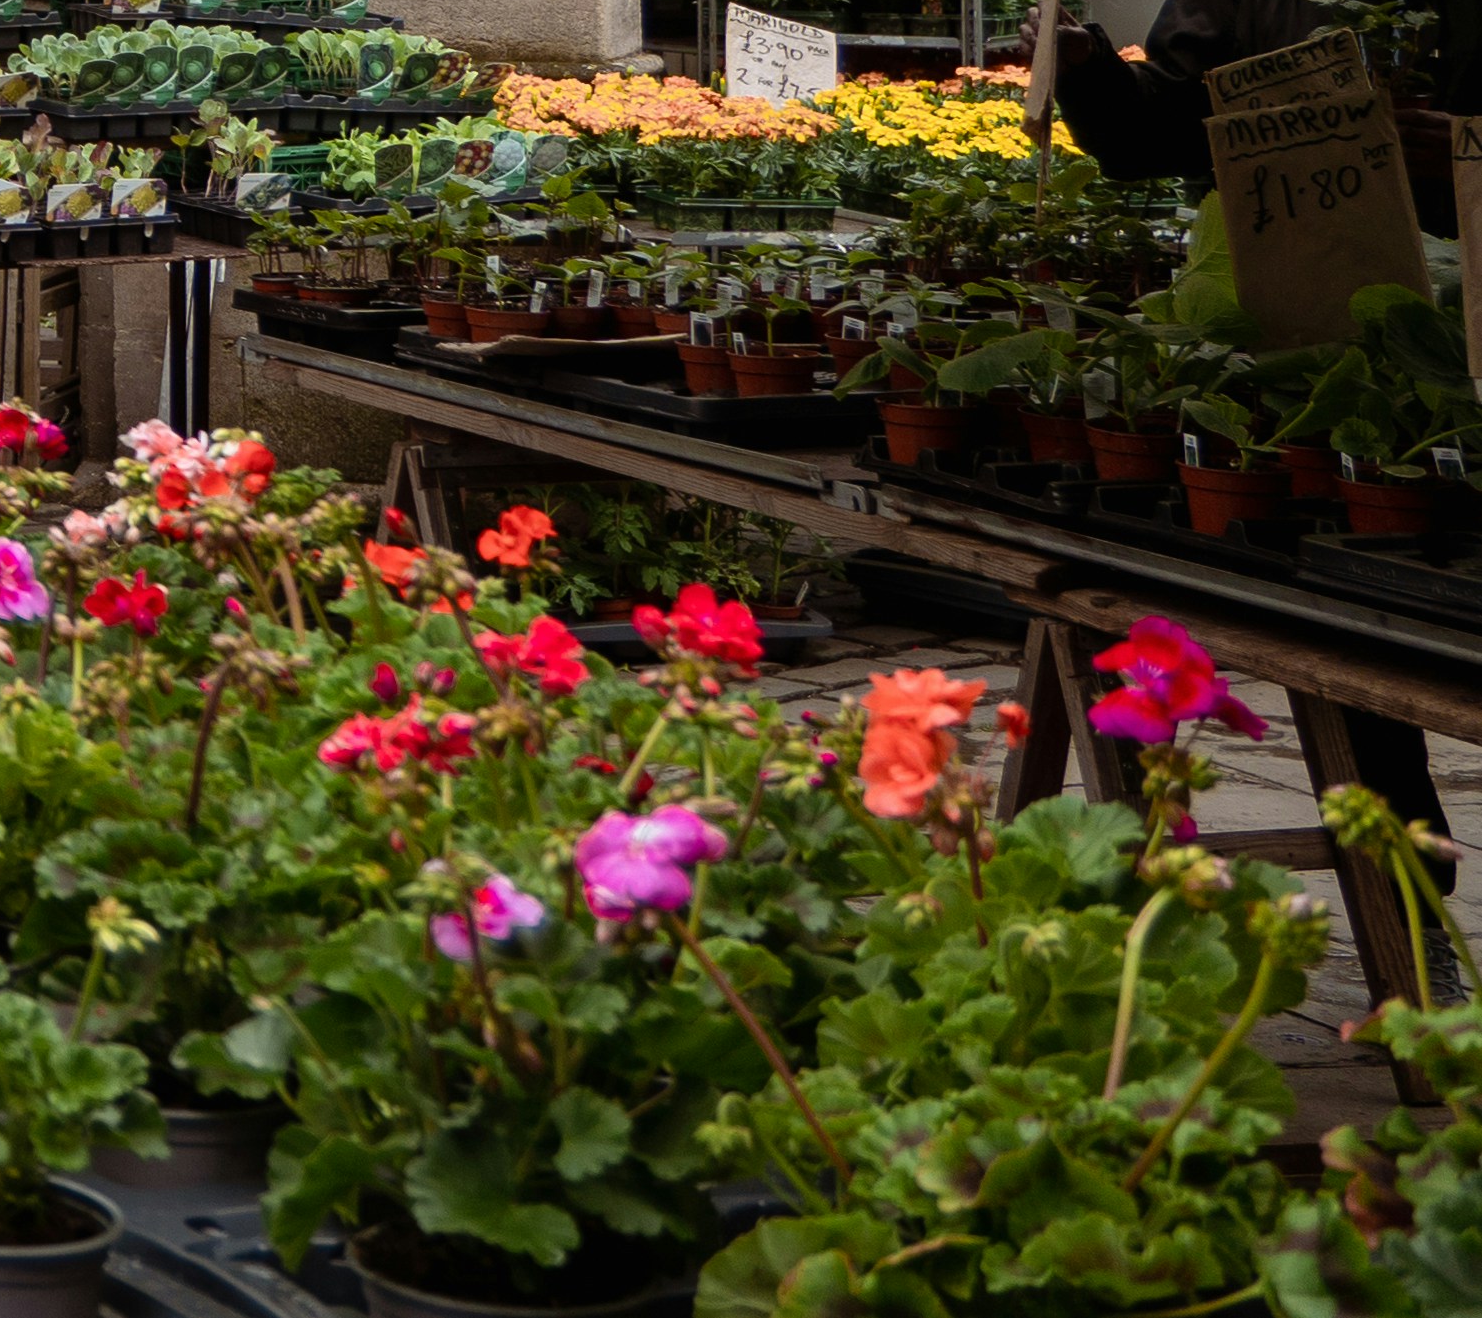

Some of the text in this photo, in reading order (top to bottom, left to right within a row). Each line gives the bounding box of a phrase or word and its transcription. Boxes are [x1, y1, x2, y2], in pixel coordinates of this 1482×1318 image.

[734, 7, 825, 39] MARIGOLD
[739, 30, 804, 61] £3.90
[736, 67, 749, 85] 2
[757, 77, 773, 86] FOR
[1216, 29, 1350, 96] COURGETTE
[1225, 98, 1376, 150] MARROW
[1361, 142, 1395, 162] POT
[1245, 165, 1362, 234] £1.80
